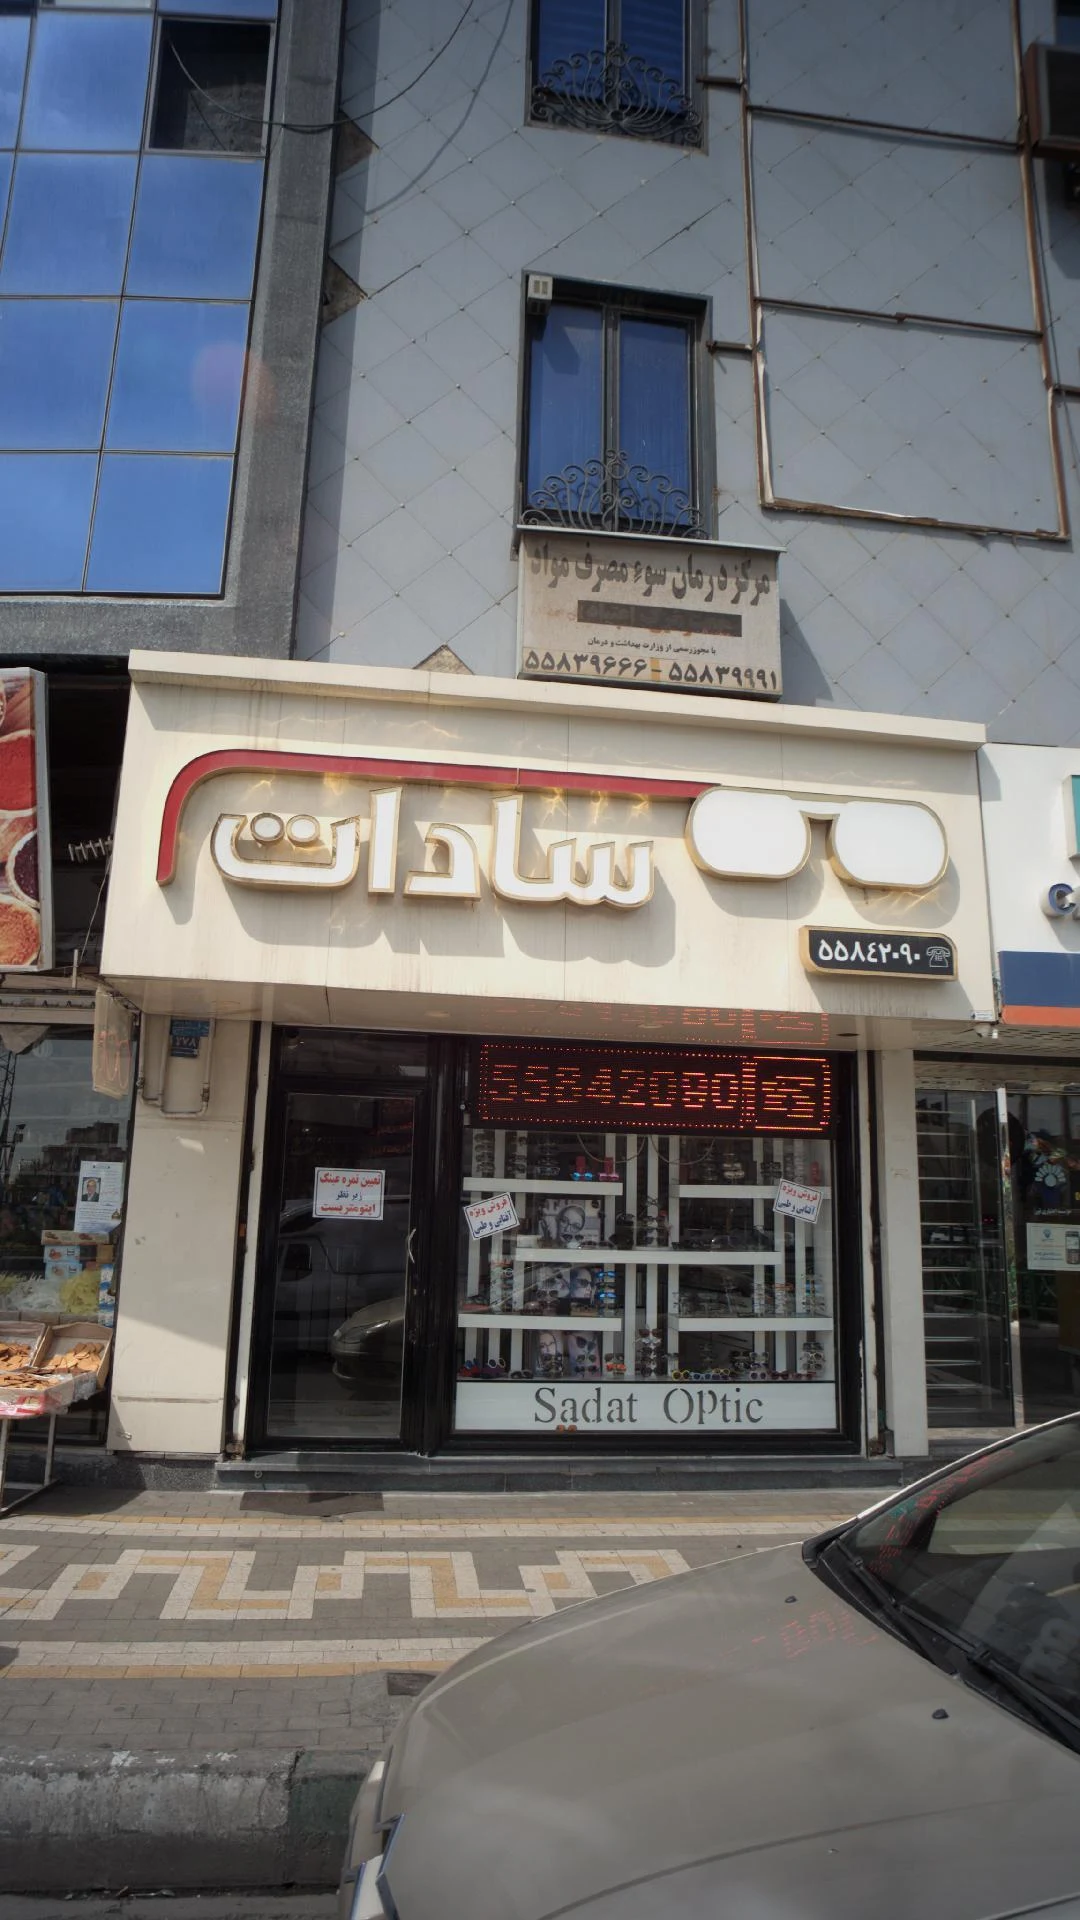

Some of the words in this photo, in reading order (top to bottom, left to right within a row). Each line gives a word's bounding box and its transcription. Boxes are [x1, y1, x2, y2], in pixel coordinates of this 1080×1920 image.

[531, 541, 569, 589] مواد
[574, 541, 628, 593] مصرف
[672, 553, 727, 603] درمان
[731, 559, 770, 606] مرکز
[587, 636, 608, 647] درمان
[615, 638, 641, 649] بهداشت
[210, 786, 655, 912] سادات
[320, 1172, 340, 1186] عینک
[341, 1174, 359, 1188] نمره
[336, 1190, 349, 1201] نظر
[782, 1185, 797, 1197] ویژه
[798, 1189, 818, 1201] فروش
[487, 1197, 508, 1213] فروش
[777, 1199, 791, 1209] طبی
[469, 1207, 487, 1218] ویژه
[474, 1220, 488, 1235] طبی
[533, 1386, 638, 1424] Sadat
